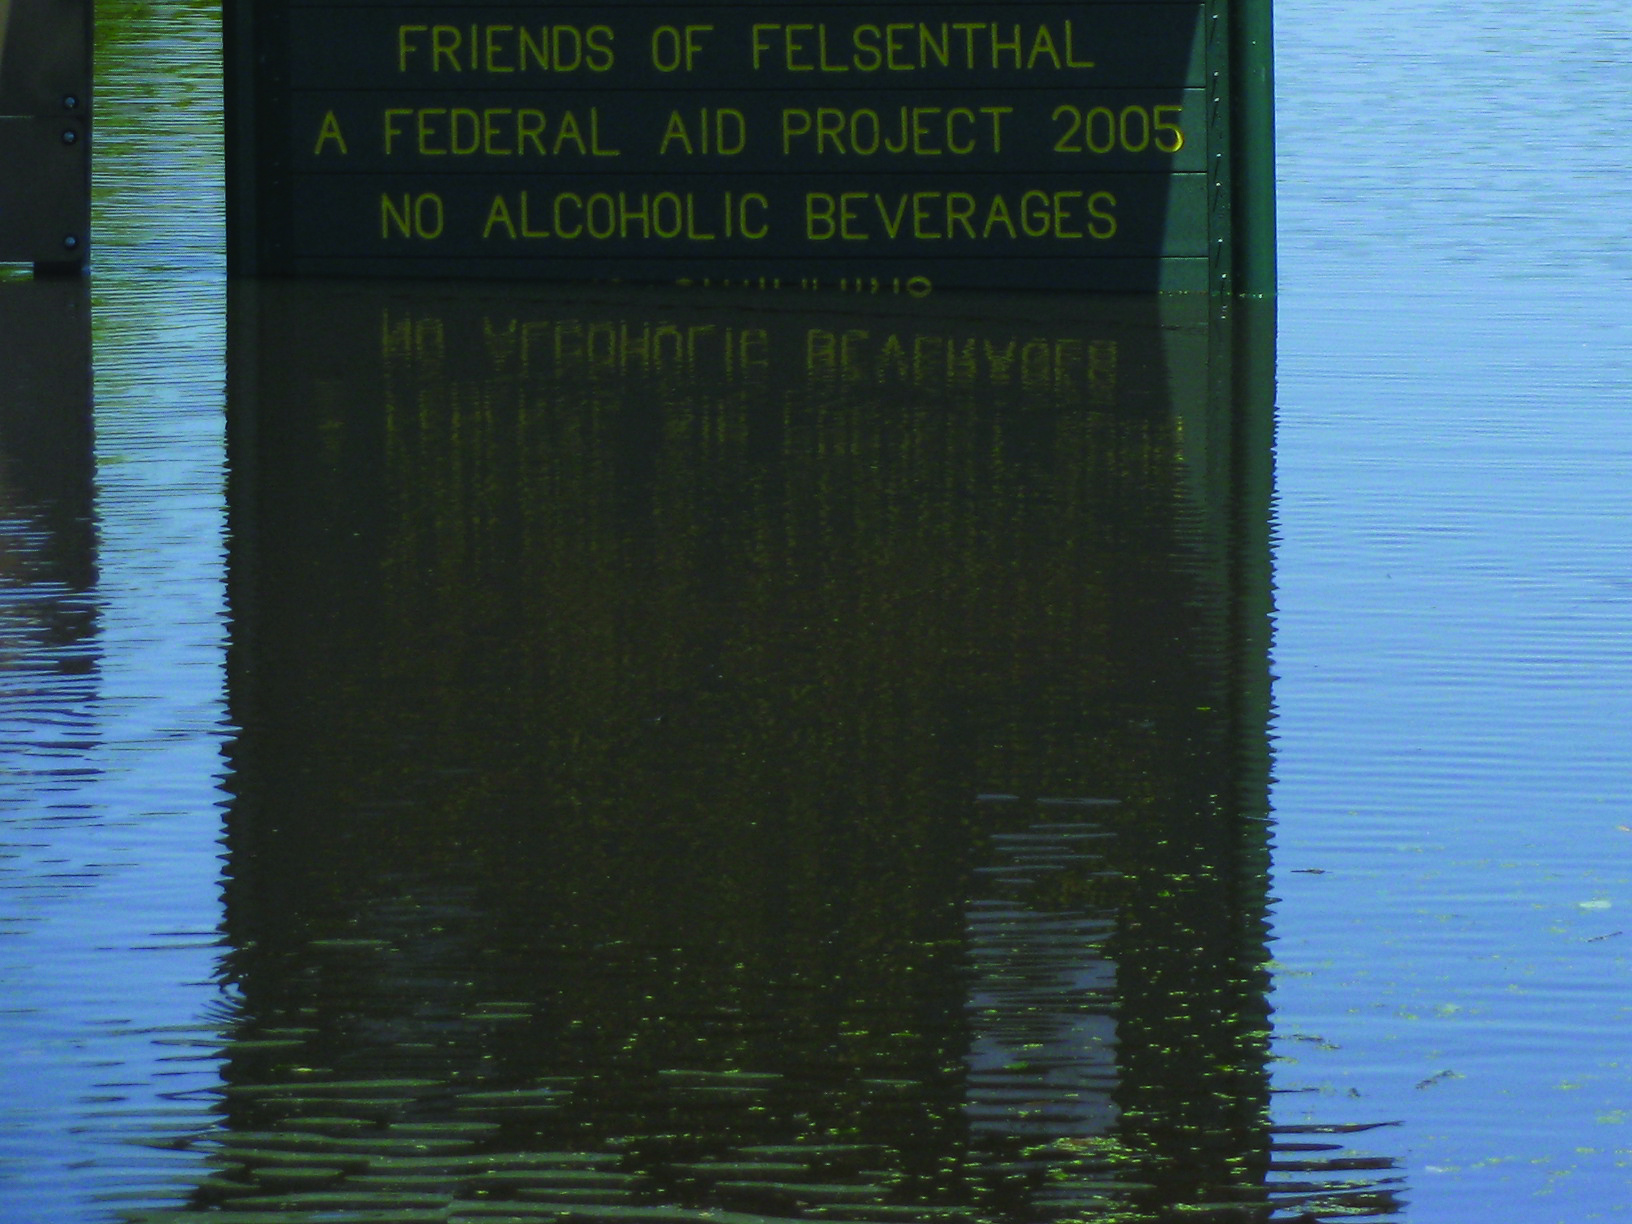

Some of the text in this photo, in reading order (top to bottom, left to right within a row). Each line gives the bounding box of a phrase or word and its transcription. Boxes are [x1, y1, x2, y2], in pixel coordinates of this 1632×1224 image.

[398, 20, 1096, 74] FRIENDS OF FELSENTHAL
[314, 104, 1186, 157] A FEDERAL AID PROJECT 2005
[381, 189, 1119, 242] NO ALCOHOLIC BEVERAGES
